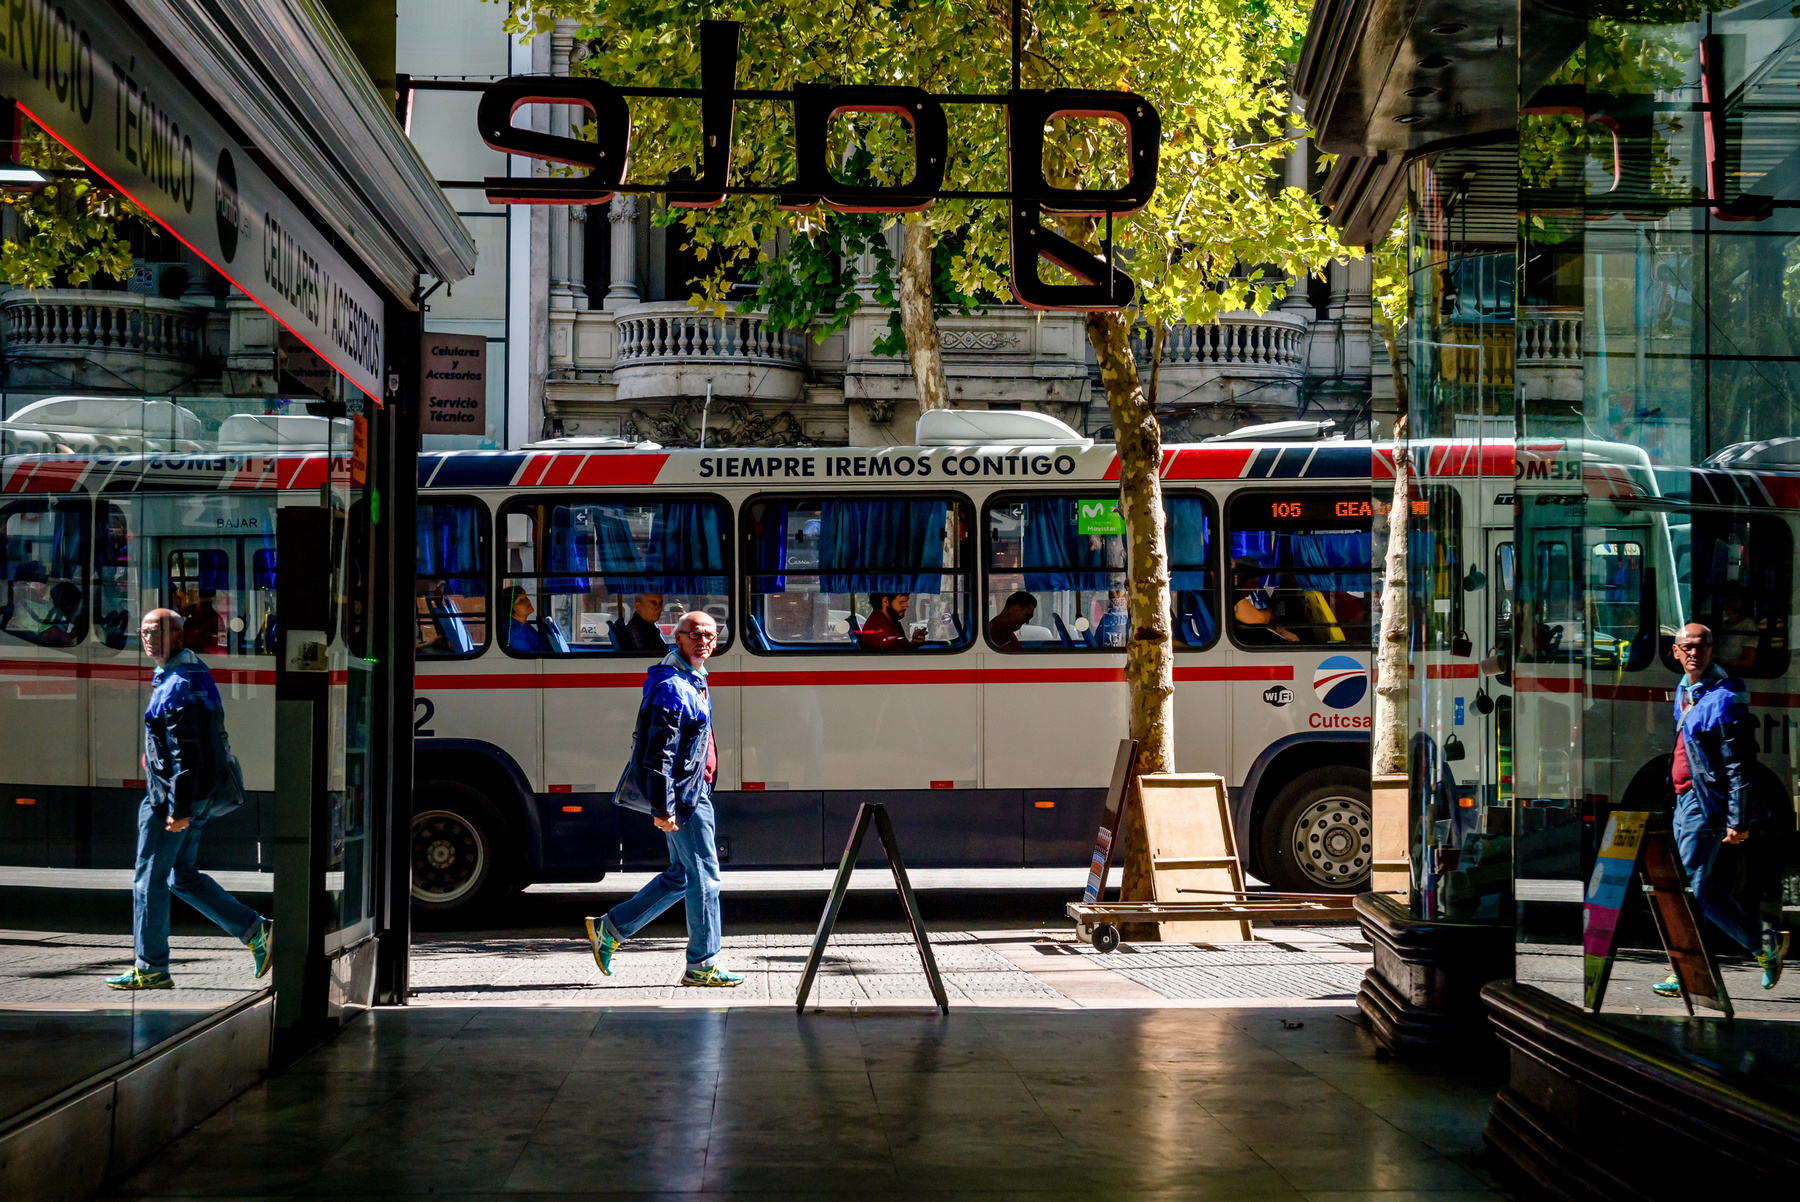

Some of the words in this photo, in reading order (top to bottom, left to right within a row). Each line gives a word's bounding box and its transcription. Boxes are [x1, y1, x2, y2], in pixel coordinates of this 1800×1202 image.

[112, 55, 194, 214] TÉCNICO
[264, 211, 320, 327] CELULARES
[323, 271, 330, 335] Y
[331, 282, 379, 379] ACCESORIOS
[431, 345, 480, 356] Celulares
[452, 361, 459, 370] y
[426, 370, 481, 381] Accesorios
[429, 397, 478, 408] Servicio
[430, 410, 475, 422] Técnico
[699, 456, 815, 478] SIEMPRE
[826, 456, 932, 477] IREMOS
[942, 454, 1075, 476] CONTIGO
[1271, 502, 1301, 518] 105
[216, 518, 258, 529] BAJAR
[1309, 712, 1371, 728] Cutcsa
